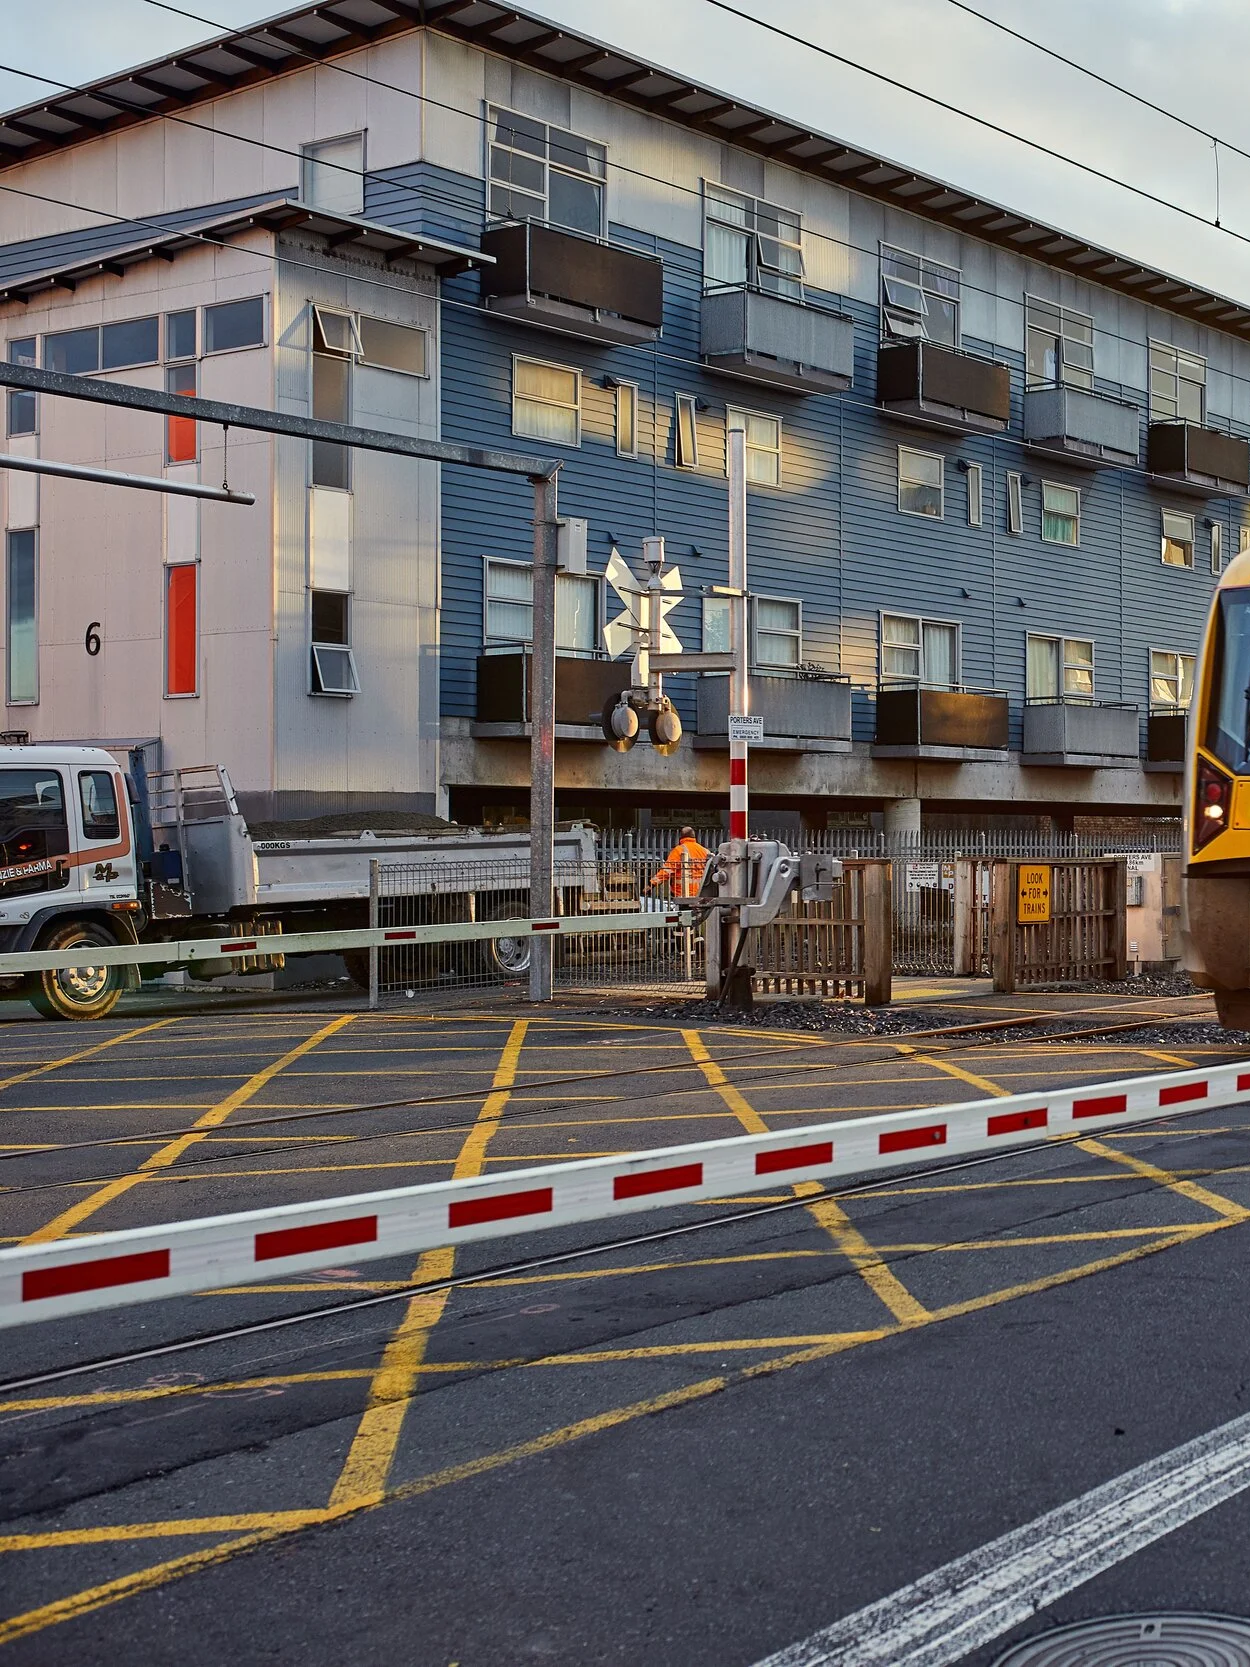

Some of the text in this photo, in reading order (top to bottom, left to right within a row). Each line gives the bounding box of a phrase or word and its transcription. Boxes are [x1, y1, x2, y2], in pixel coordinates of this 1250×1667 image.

[85, 621, 101, 656] 6
[730, 716, 763, 725] PORTERS AVE
[257, 842, 291, 850] 000KGS
[1026, 872, 1043, 884] LOOK
[1028, 887, 1041, 899] FOR
[1023, 902, 1046, 915] TRAINS
